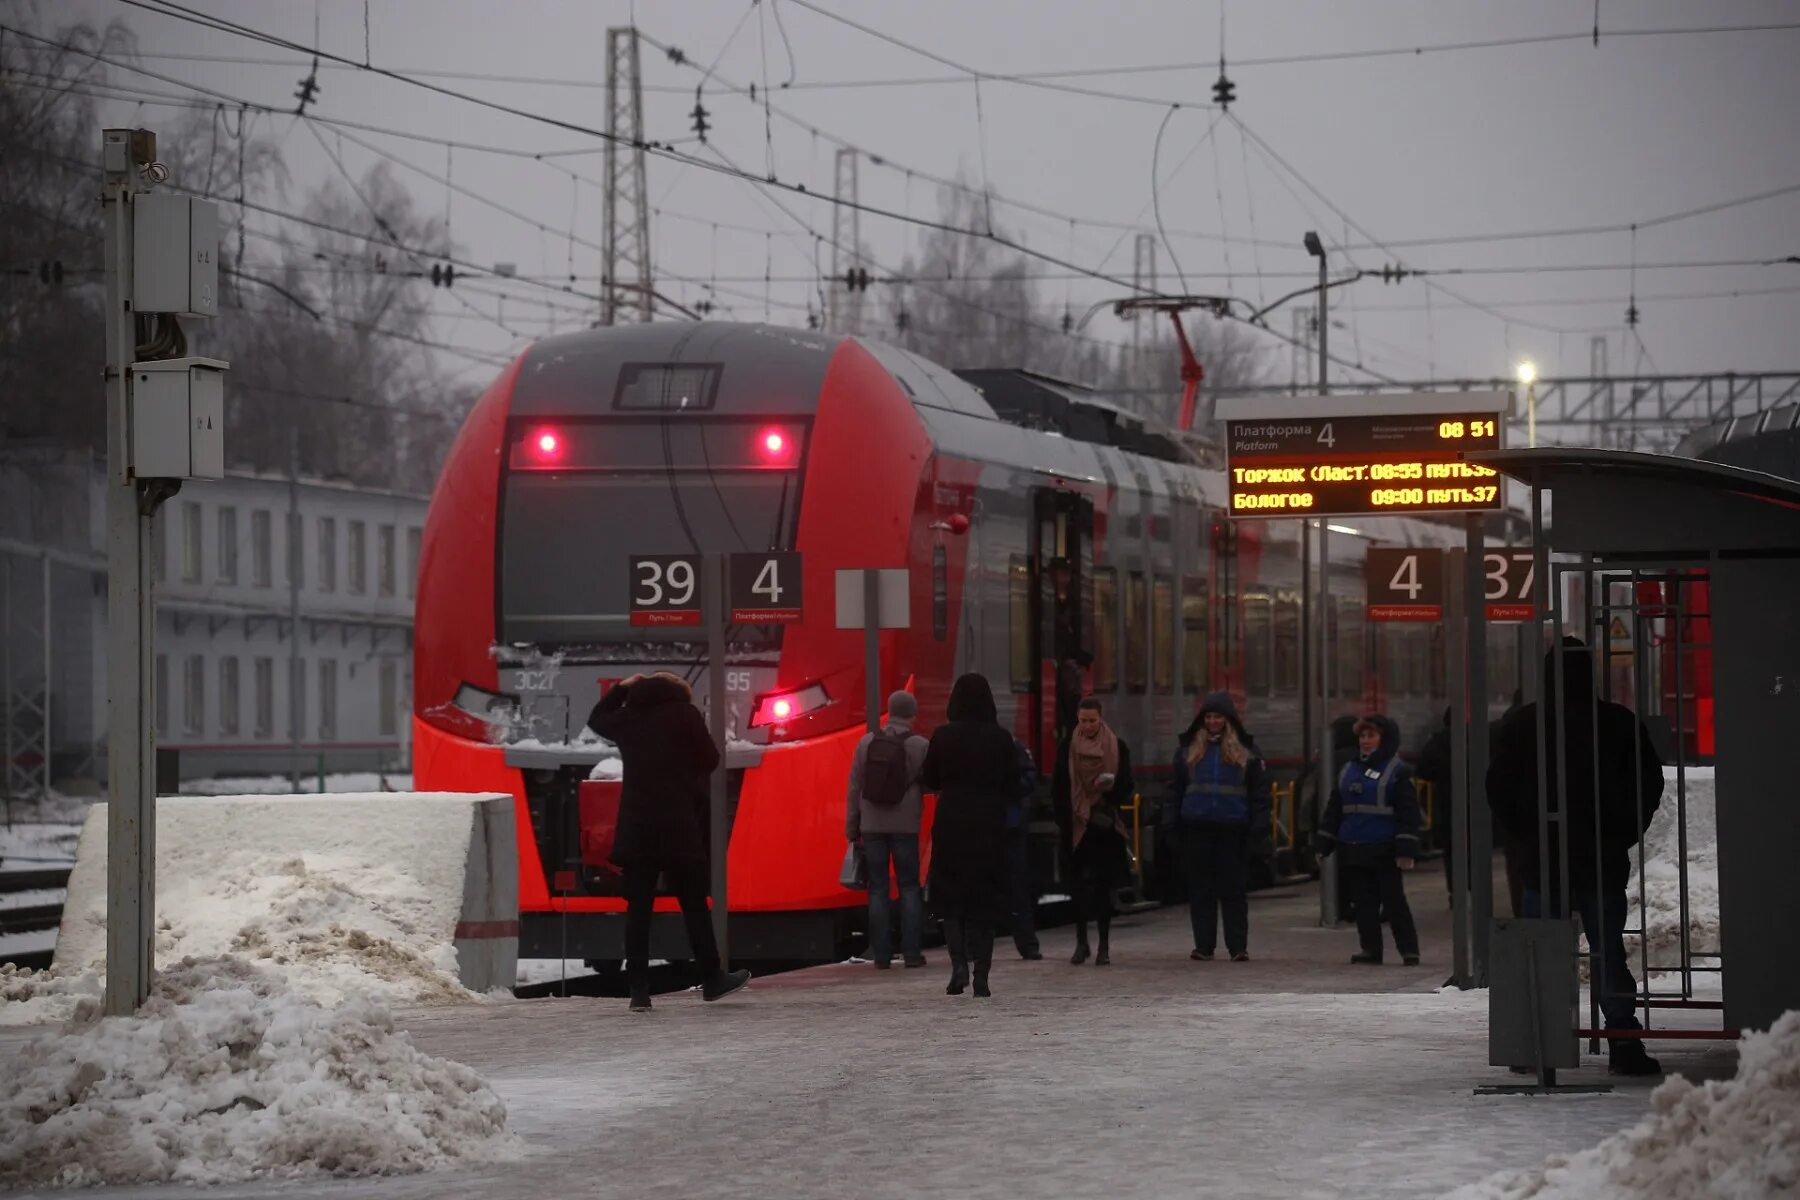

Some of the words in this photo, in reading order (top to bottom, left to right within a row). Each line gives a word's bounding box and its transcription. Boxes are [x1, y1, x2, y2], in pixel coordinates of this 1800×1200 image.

[1234, 423, 1312, 438] Платформа
[1317, 423, 1336, 448] 4
[1440, 422, 1464, 438] 08
[1470, 421, 1493, 437] 51
[1235, 441, 1278, 451] Platform
[1233, 468, 1306, 483] Торжок
[1370, 463, 1423, 479] 08:55
[1234, 492, 1313, 508] Бологое
[1371, 488, 1424, 505] 09:00
[635, 560, 695, 606] 39
[751, 559, 784, 603] 4
[1389, 555, 1422, 600] 4
[1484, 554, 1535, 600] 37
